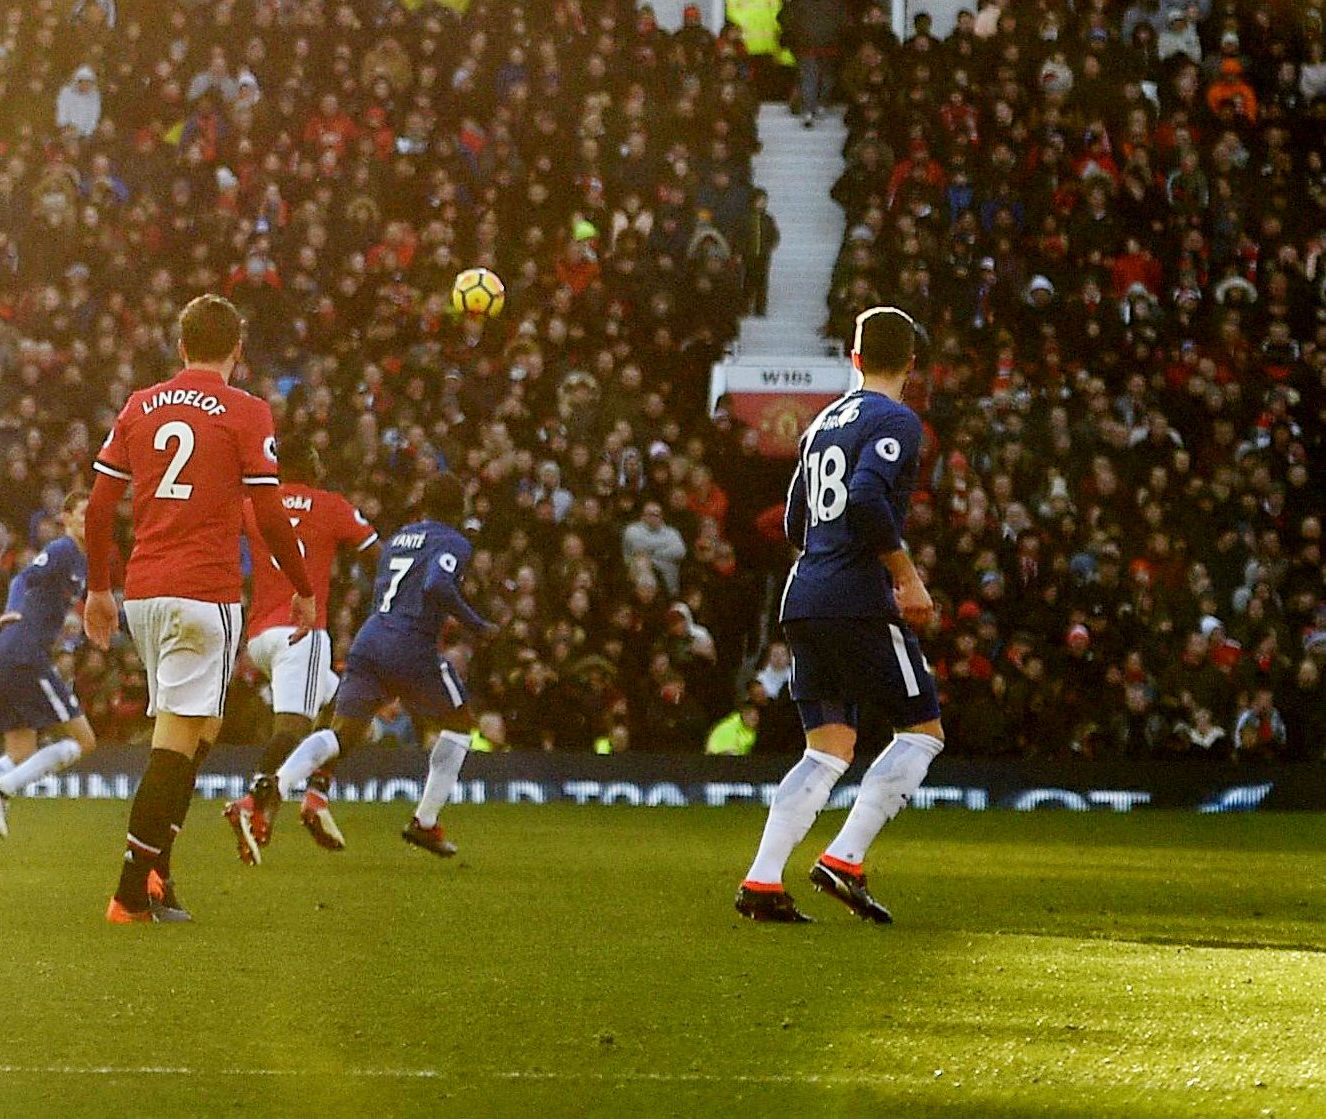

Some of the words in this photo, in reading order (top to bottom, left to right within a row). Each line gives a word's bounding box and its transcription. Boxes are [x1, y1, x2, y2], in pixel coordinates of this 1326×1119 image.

[141, 388, 227, 416] LINDELOF
[153, 420, 195, 500] 2
[807, 444, 848, 528] 18
[379, 557, 415, 613] 7
